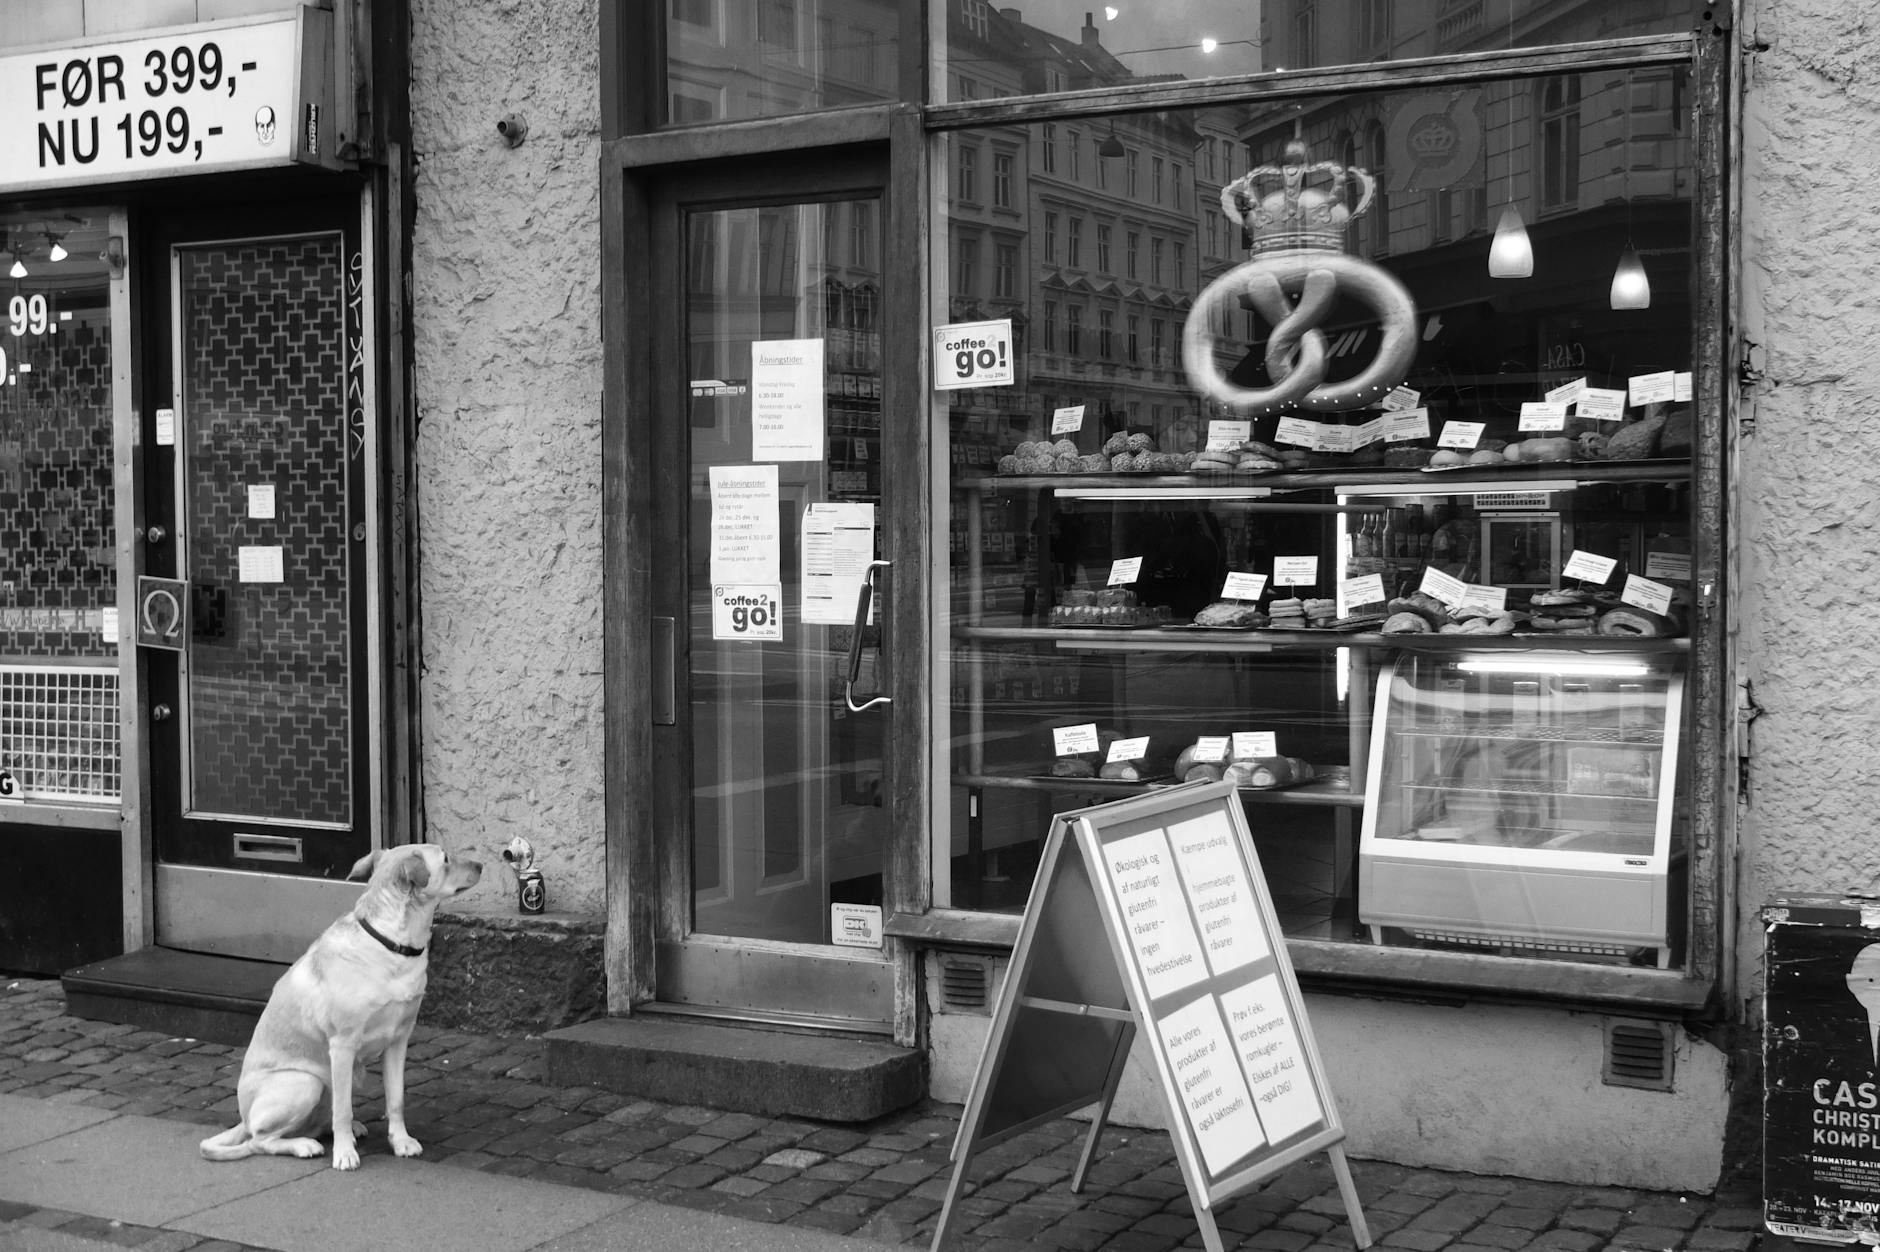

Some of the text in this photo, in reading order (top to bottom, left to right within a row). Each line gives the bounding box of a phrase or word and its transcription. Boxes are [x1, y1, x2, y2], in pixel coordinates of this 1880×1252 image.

[36, 42, 257, 110] FØR 399,-
[38, 106, 223, 167] NU 199,-
[956, 340, 1006, 378] go!
[732, 601, 776, 632] go!
[1114, 853, 1160, 874] Økologisk og
[1122, 874, 1160, 894] af naturligt
[1128, 897, 1158, 917] glutenfri
[1134, 919, 1159, 935] råvarer
[1205, 915, 1231, 934] glutenfri
[1141, 942, 1160, 957] ingen
[1210, 936, 1233, 952] råvarer
[1146, 952, 1193, 977] hvedestivelse
[1232, 1009, 1248, 1022] Prøv
[1169, 1025, 1202, 1049] Alle vores
[1239, 1016, 1285, 1043] vores berømte
[1176, 1041, 1216, 1071] produkter af
[1184, 1067, 1212, 1093] glutenfri
[1252, 1057, 1295, 1084] Elskes af ALLE
[1191, 1086, 1223, 1113] råvarer er
[1277, 1080, 1293, 1095] DIG!
[1813, 1078, 1877, 1109] CAS
[1198, 1096, 1244, 1132] også laktosefri
[1813, 1109, 1880, 1130] CHRIST
[1813, 1128, 1880, 1150] KOMPL
[1812, 1155, 1857, 1167] DRAMATISK
